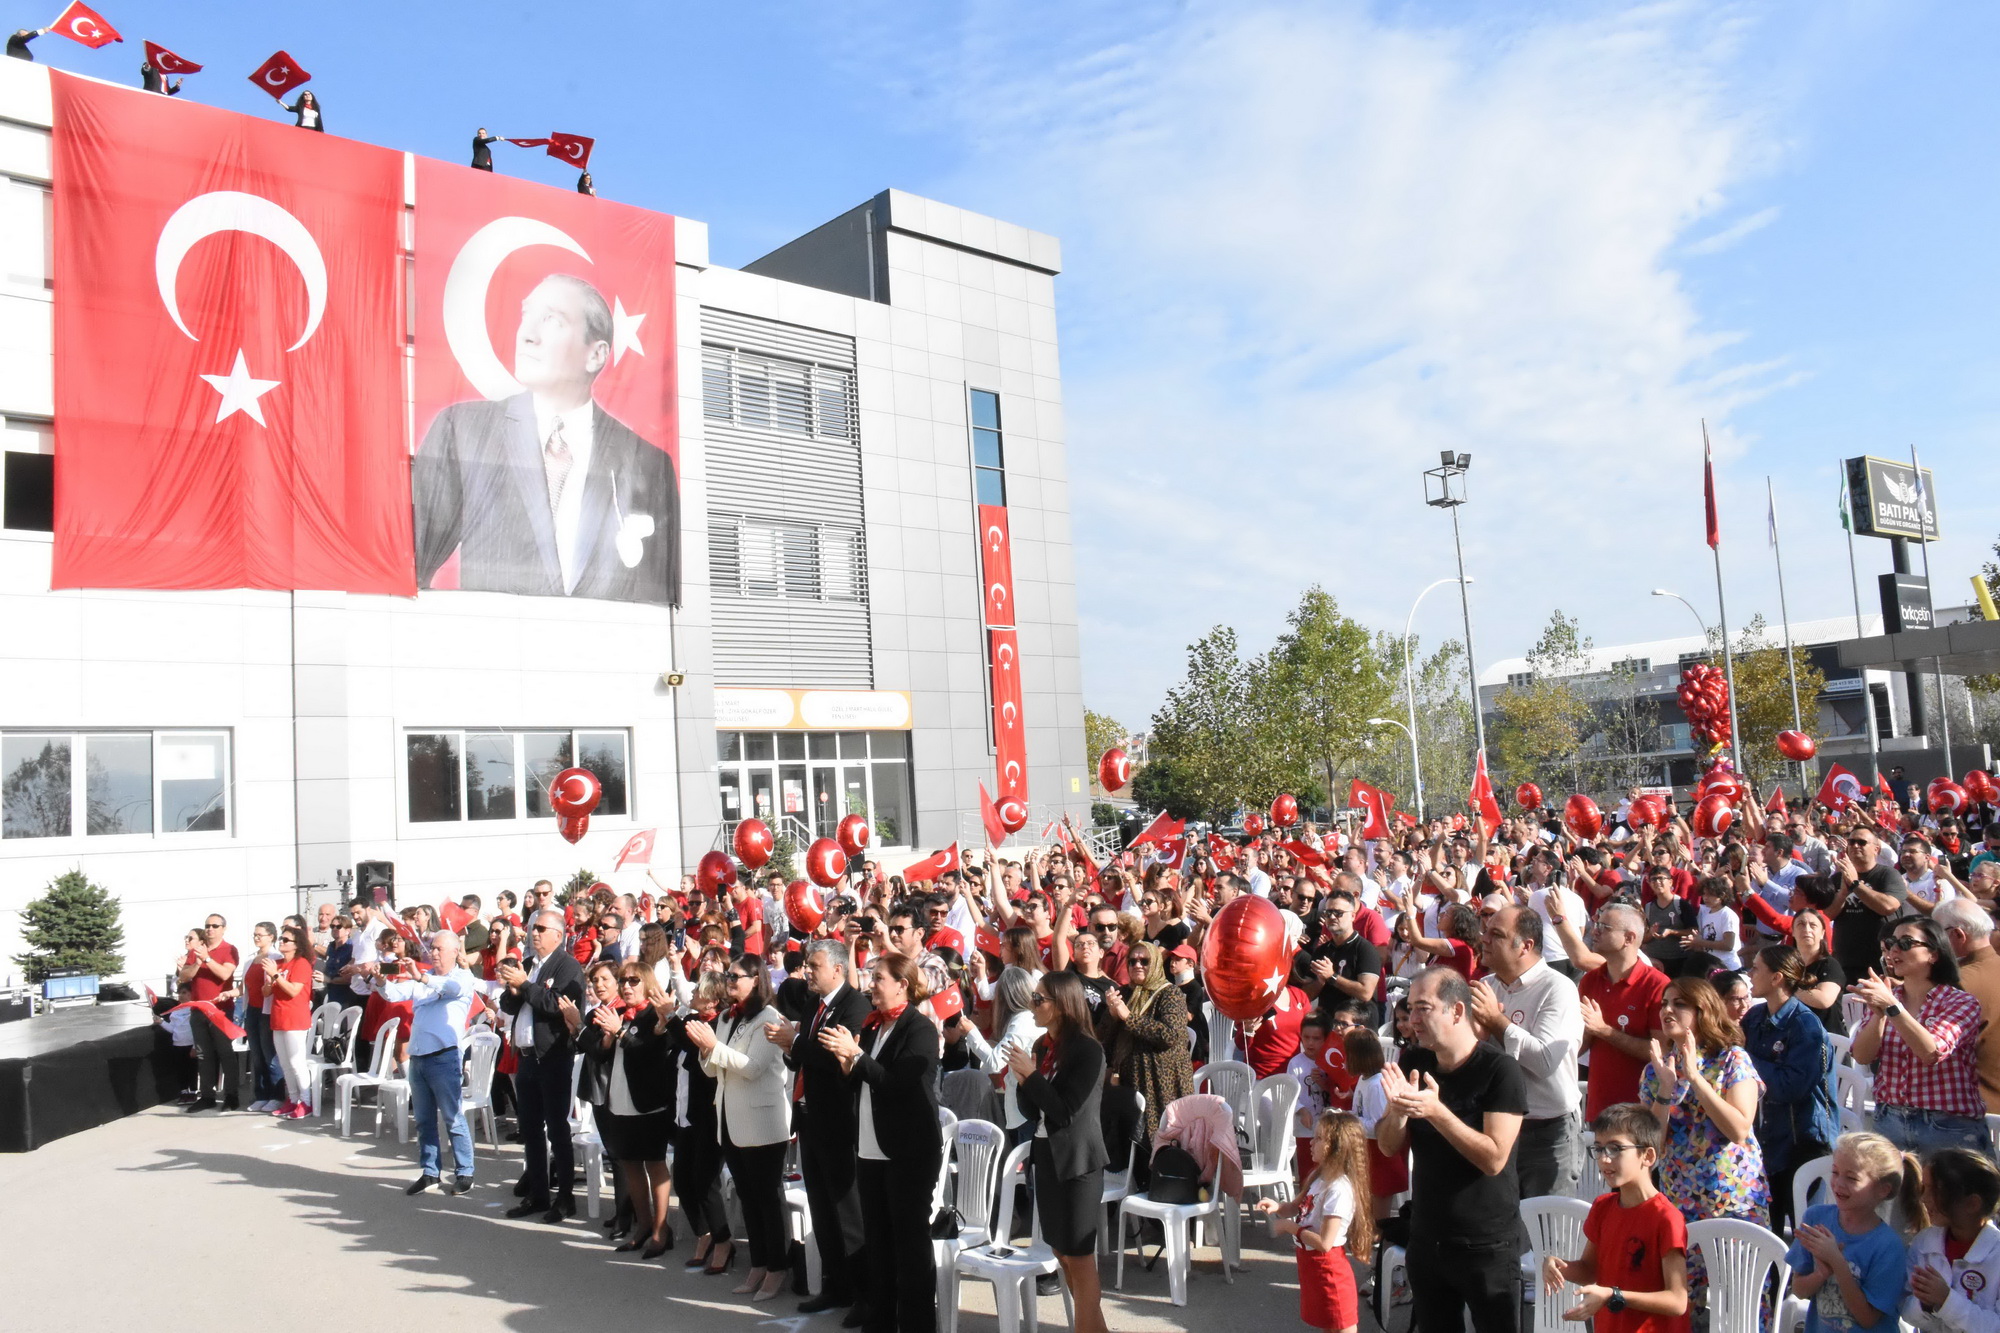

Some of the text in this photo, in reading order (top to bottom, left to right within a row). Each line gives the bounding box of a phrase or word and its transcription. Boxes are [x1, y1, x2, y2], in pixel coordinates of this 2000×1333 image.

[1878, 502, 1933, 524] BATI PALS
[959, 1131, 989, 1143] PROTOKOL
